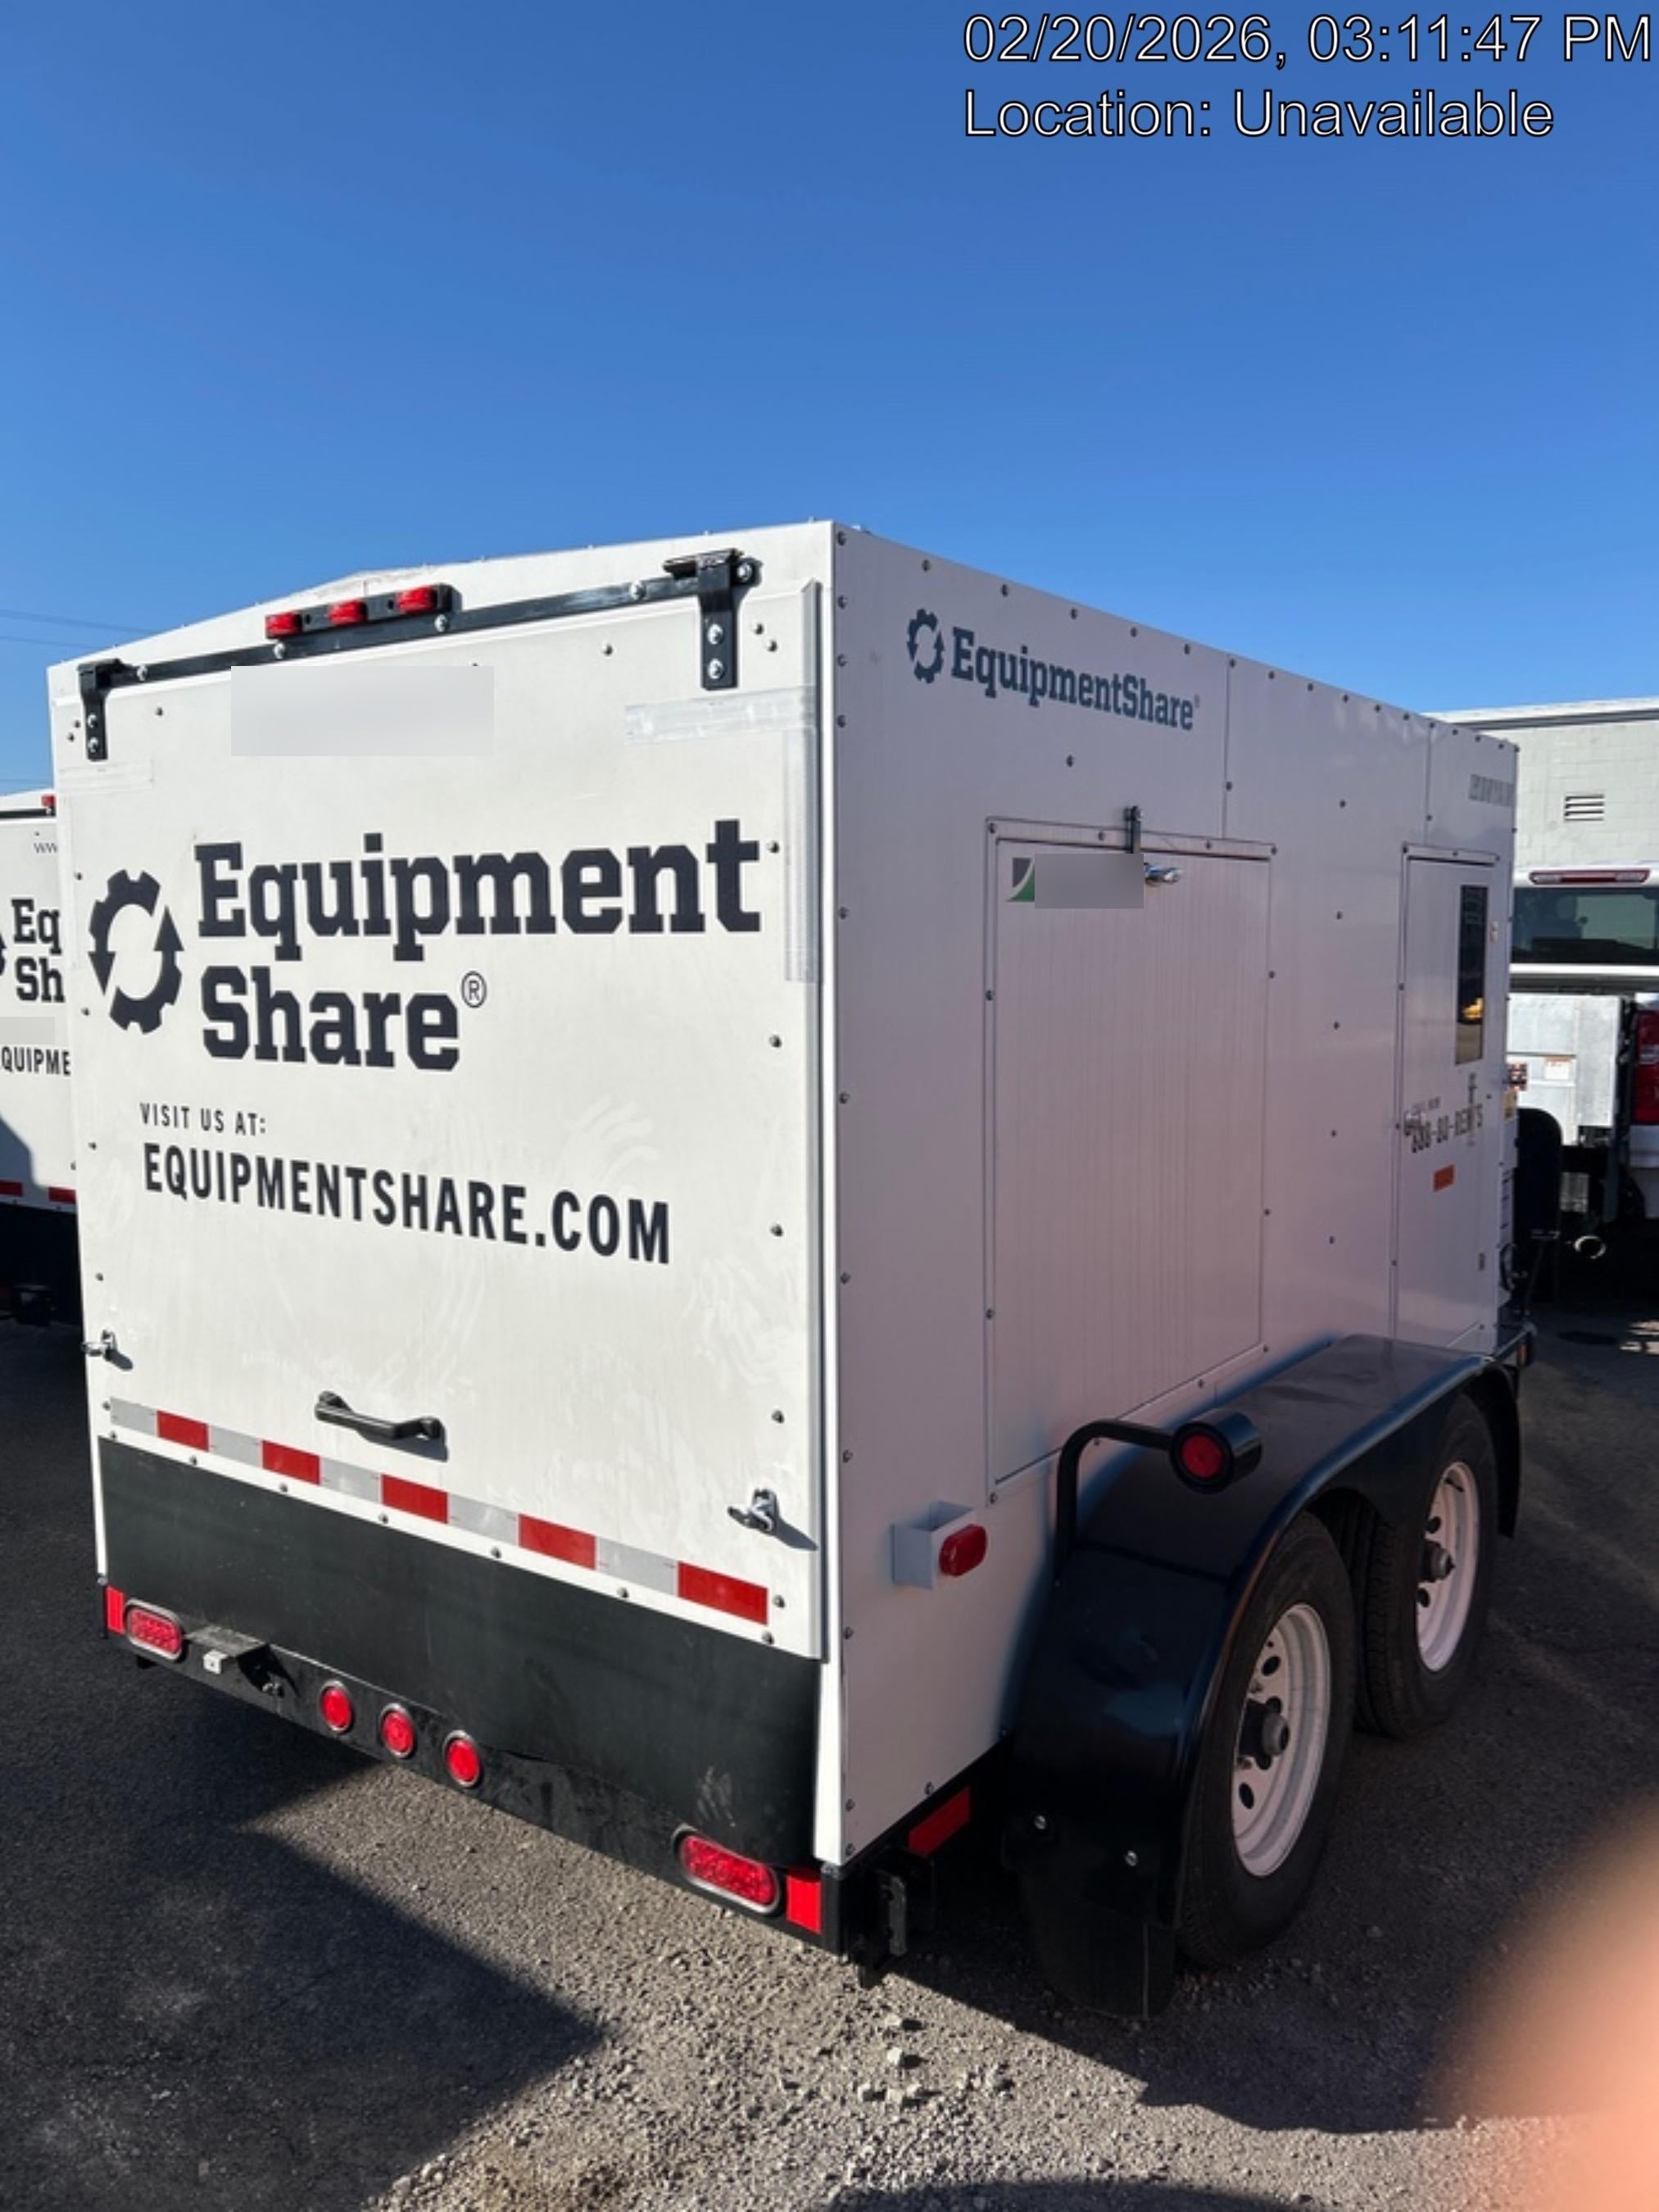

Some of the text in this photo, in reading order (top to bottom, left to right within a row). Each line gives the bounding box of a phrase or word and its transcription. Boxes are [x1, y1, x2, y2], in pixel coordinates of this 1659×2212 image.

[195, 818, 761, 962] Equipment
[140, 1103, 265, 1135] VISIT US AT:
[144, 1142, 669, 1265] EQUIPMENTSHARE.COM
